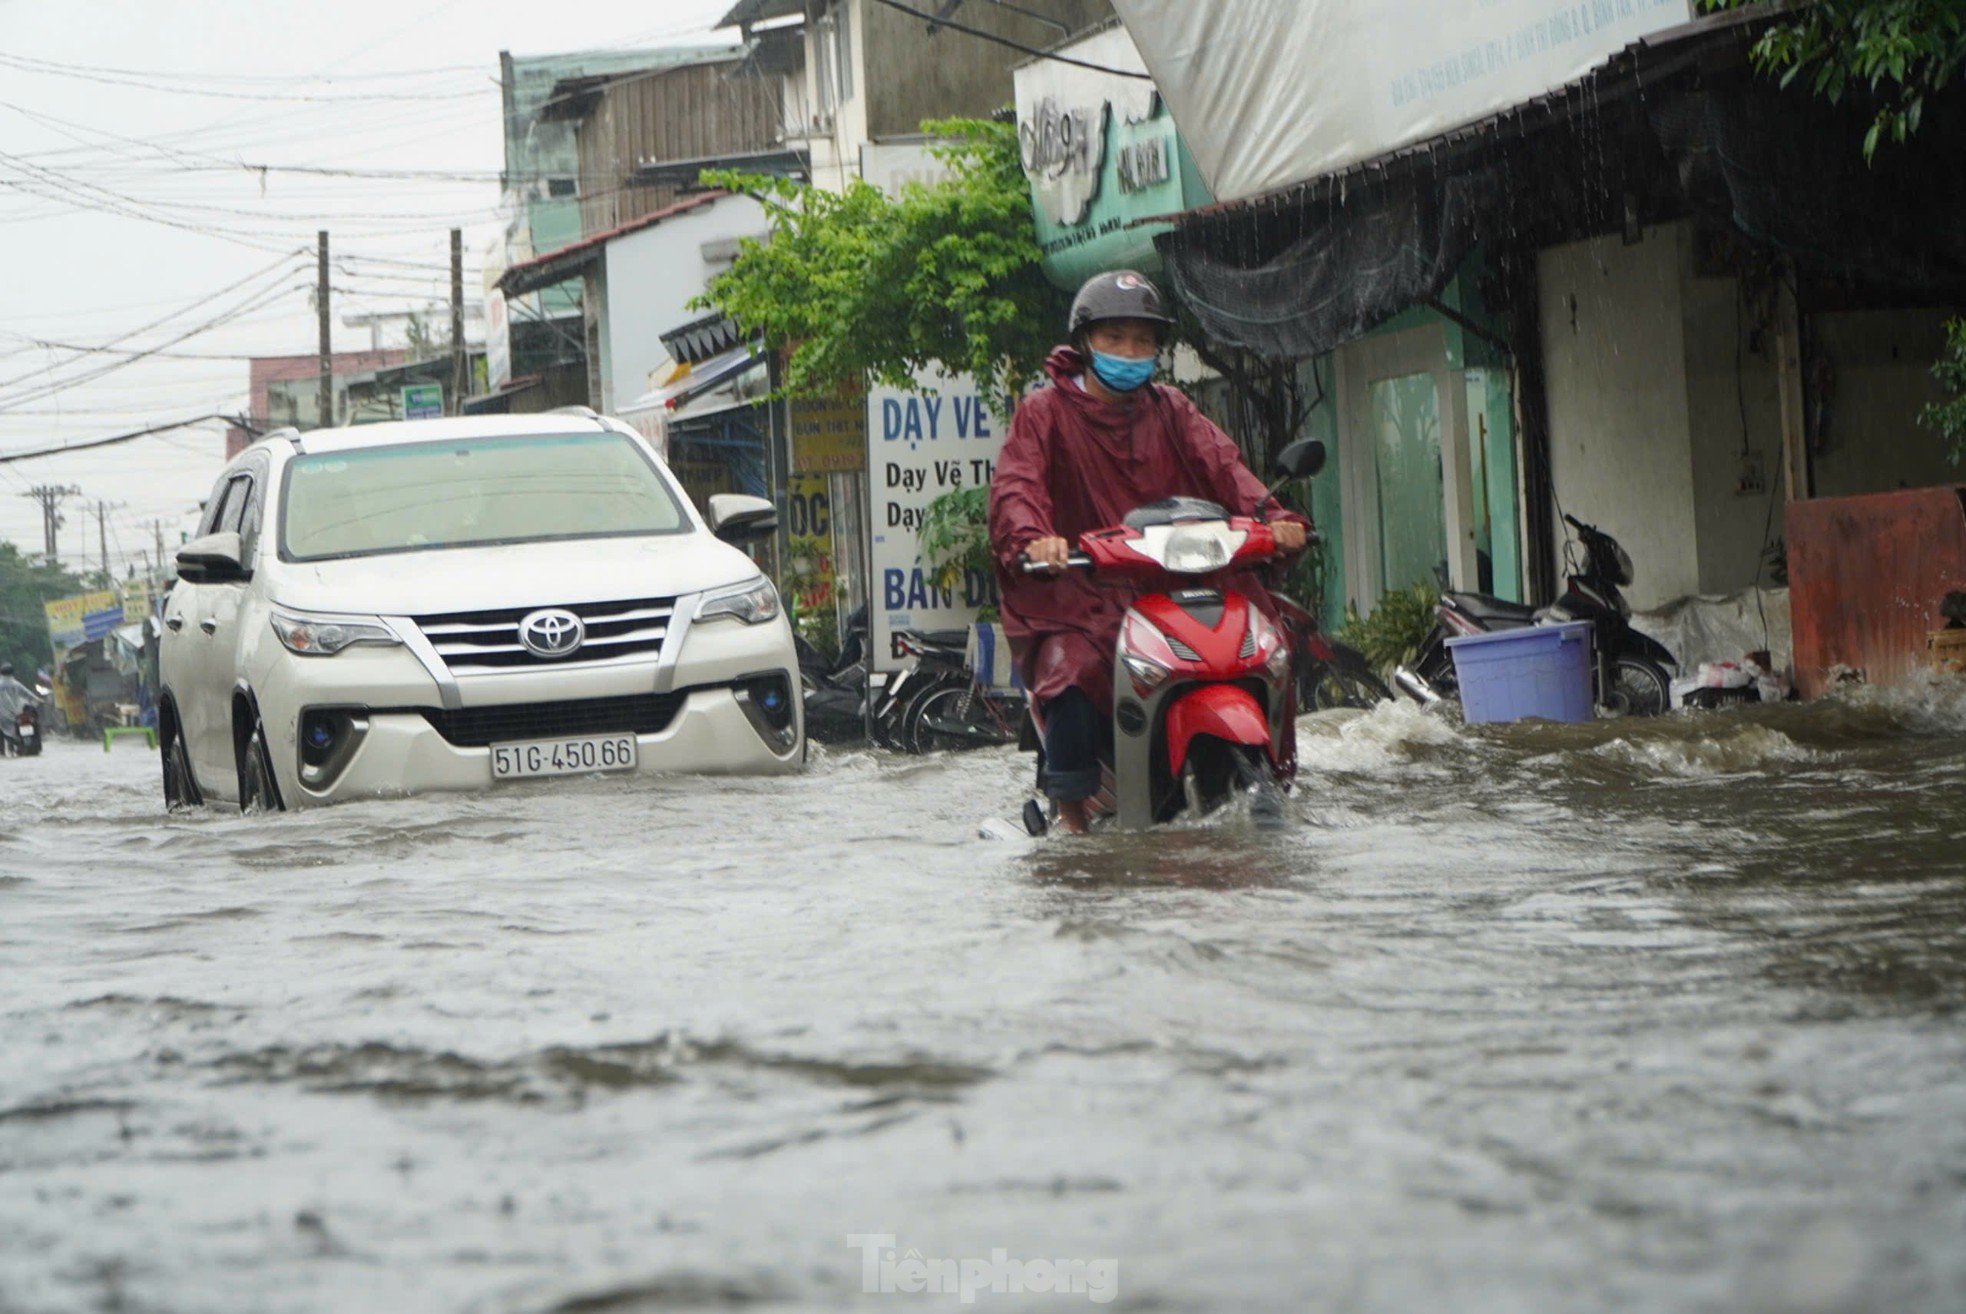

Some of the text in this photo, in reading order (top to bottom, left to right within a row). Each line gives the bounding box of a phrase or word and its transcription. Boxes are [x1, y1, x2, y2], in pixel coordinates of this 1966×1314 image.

[883, 396, 942, 450] DẠY
[886, 462, 926, 493] Dạy
[935, 459, 962, 486] Vẽ
[887, 502, 926, 533] Dạy
[496, 739, 631, 774] 51G-450.66
